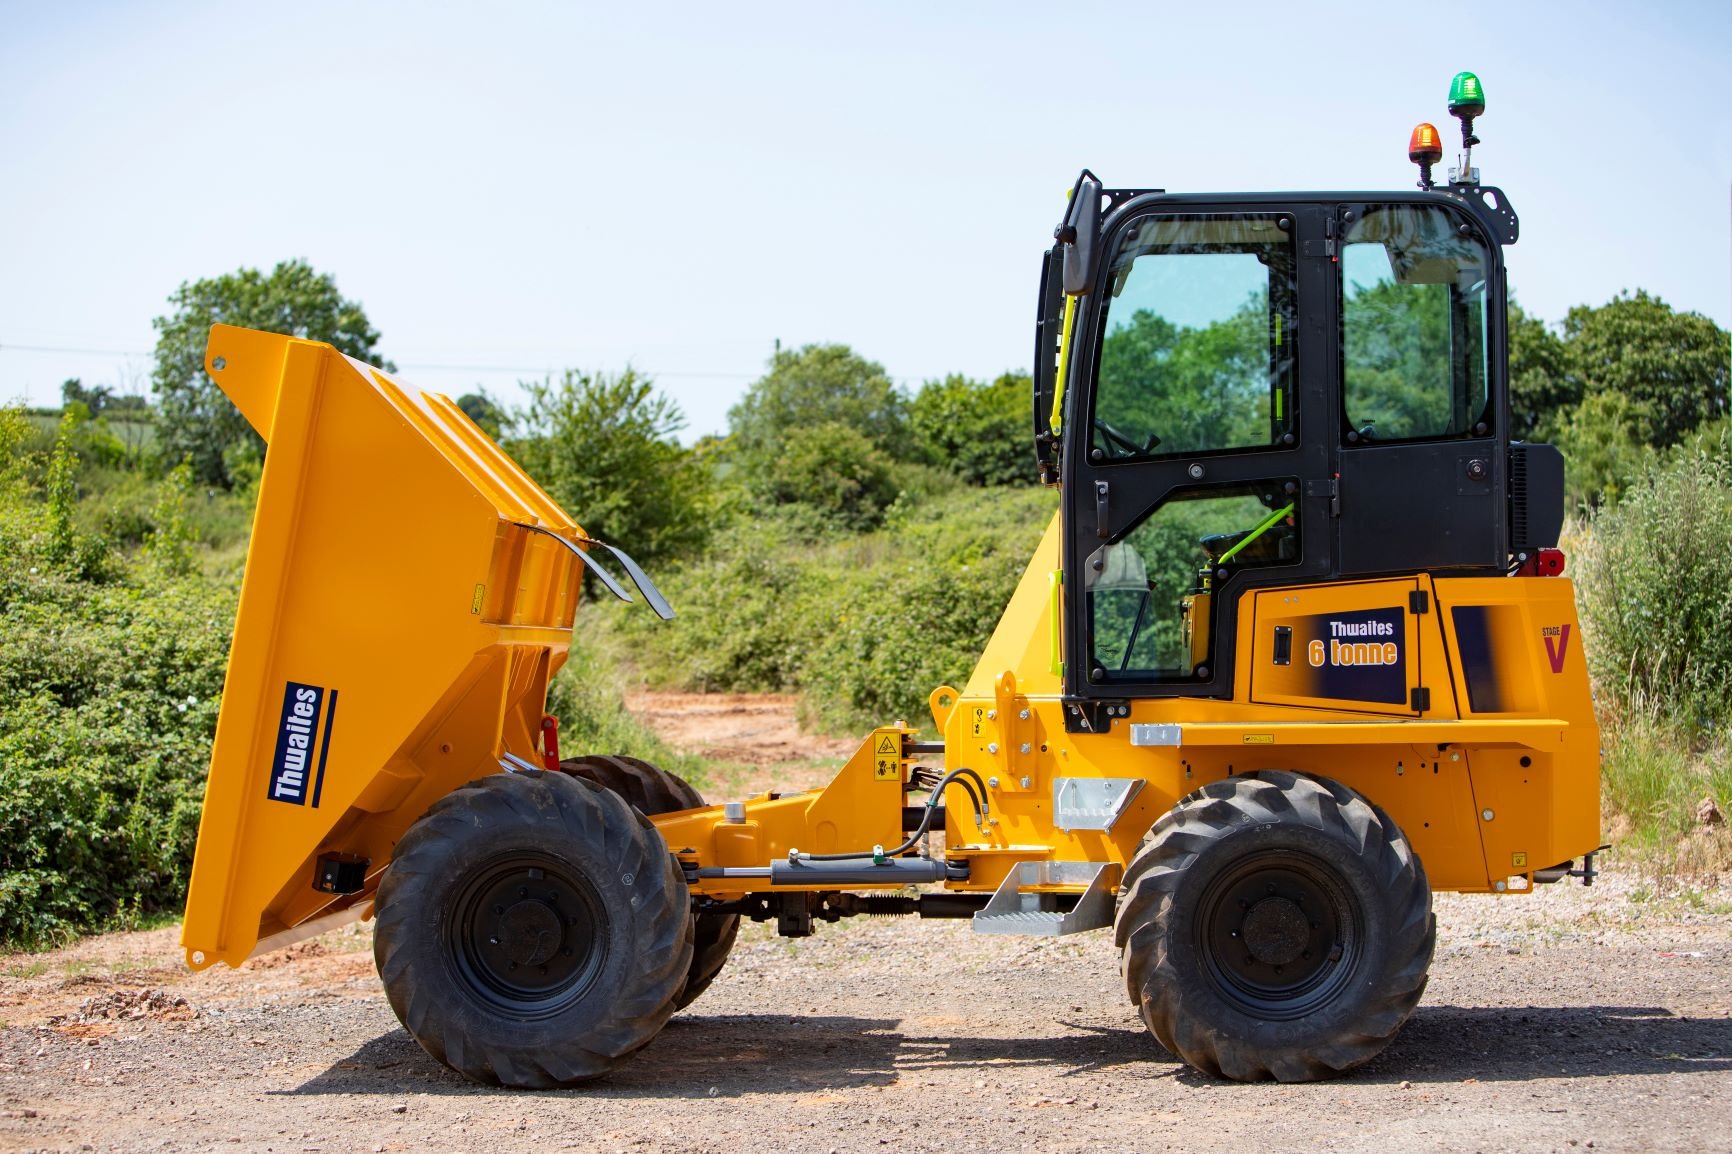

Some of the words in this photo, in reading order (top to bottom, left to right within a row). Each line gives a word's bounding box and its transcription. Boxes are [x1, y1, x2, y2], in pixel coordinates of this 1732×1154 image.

[1330, 621, 1393, 636] Thwaites
[1542, 626, 1560, 636] STAGE
[1309, 640, 1325, 667] 6
[1331, 639, 1397, 666] tonne
[1544, 624, 1571, 673] V
[274, 688, 317, 798] Thwaites
